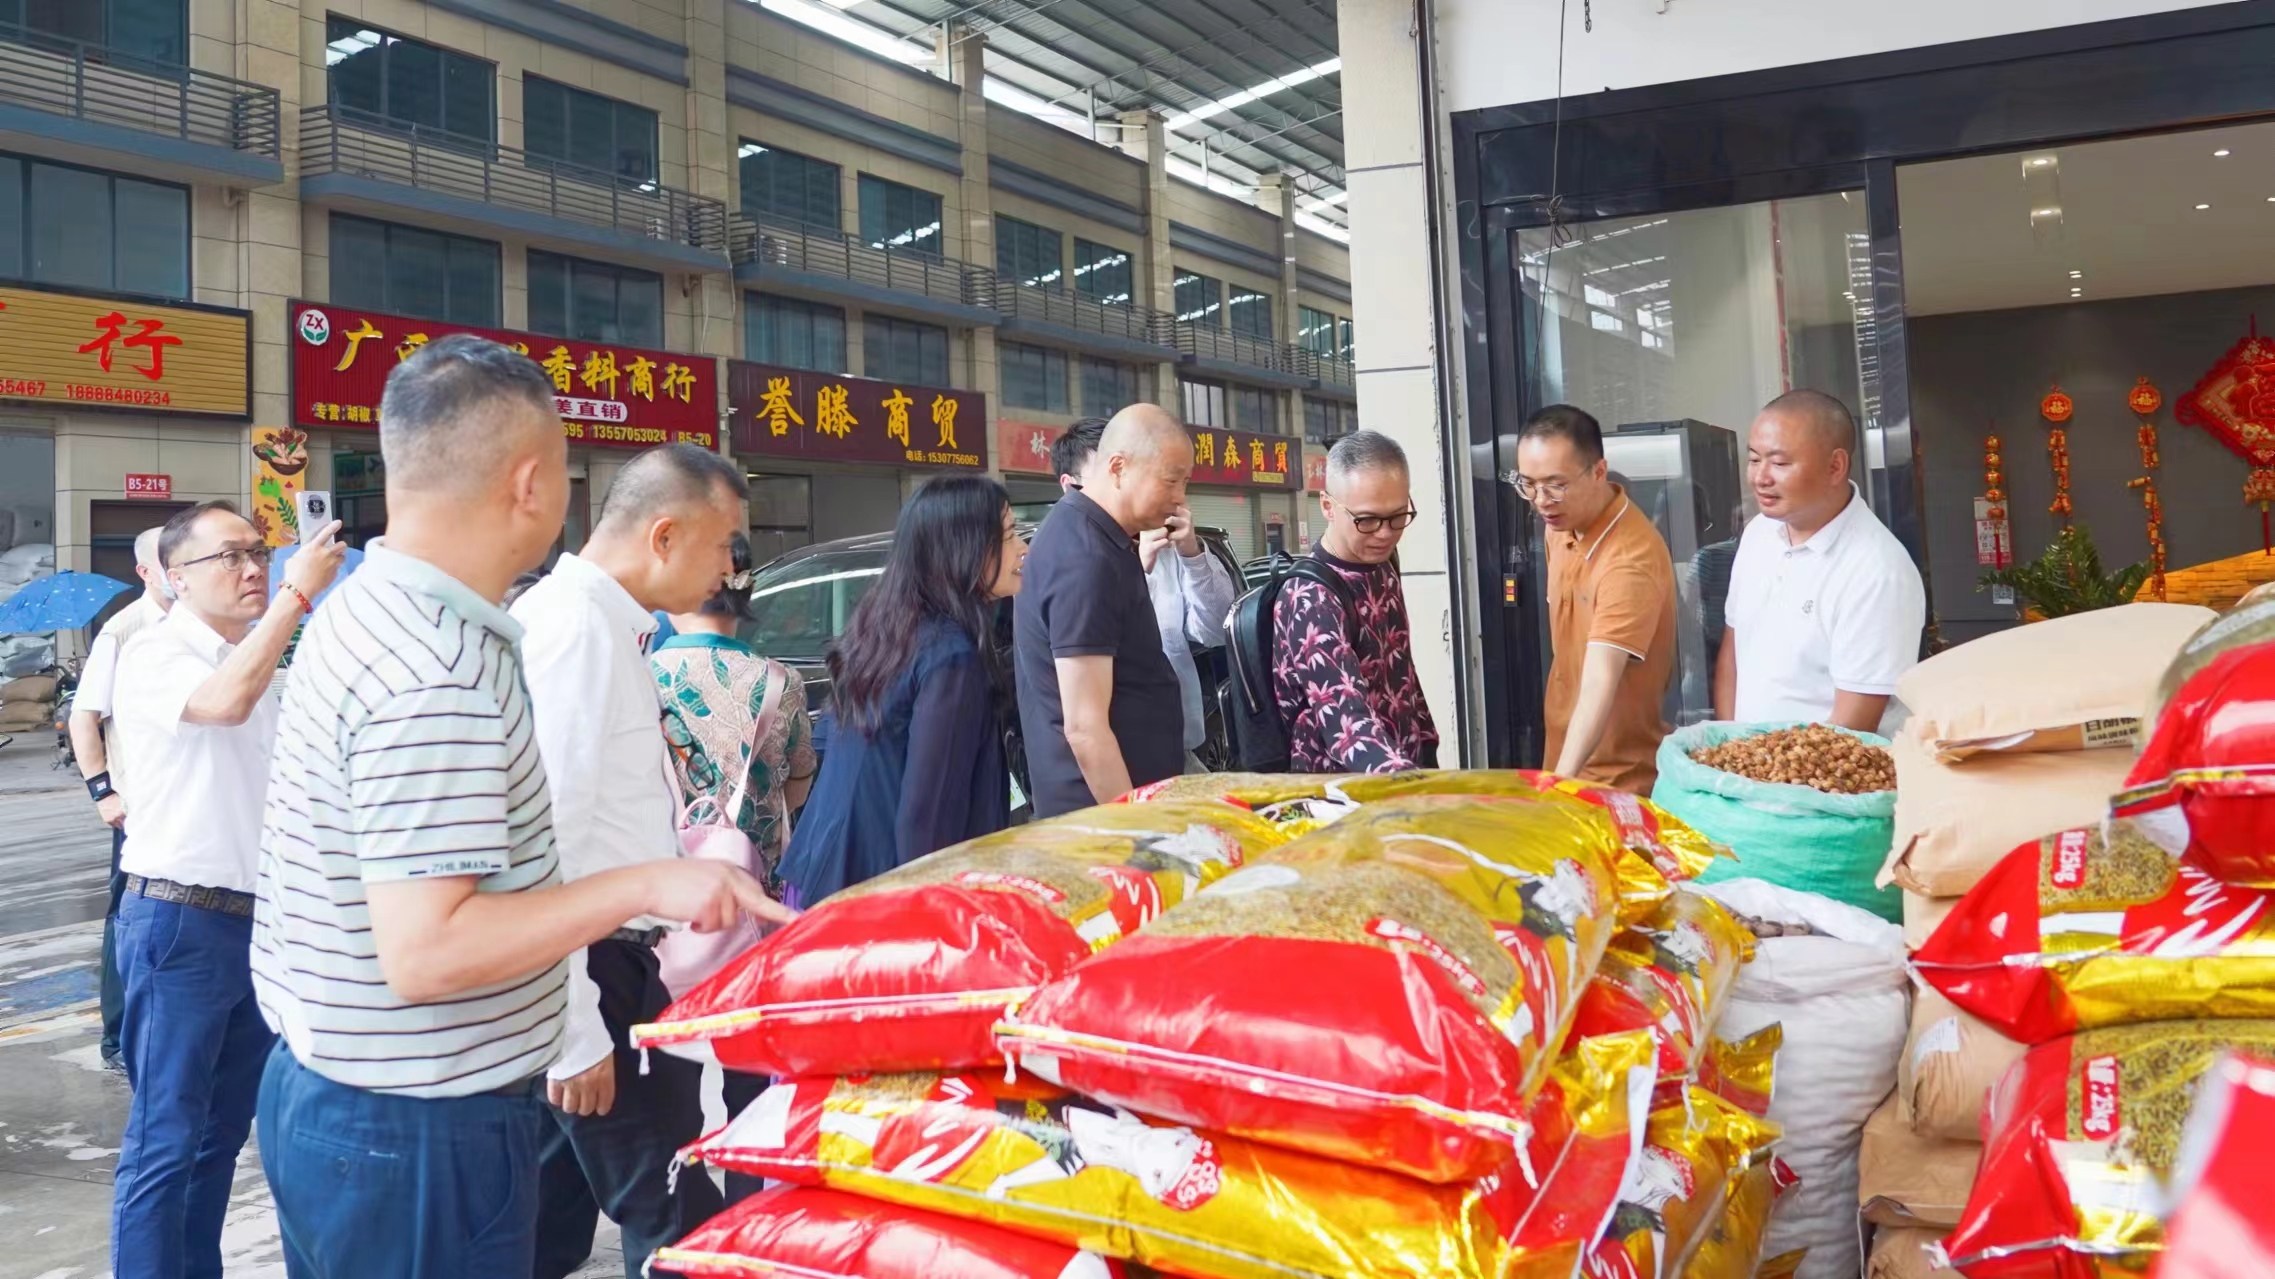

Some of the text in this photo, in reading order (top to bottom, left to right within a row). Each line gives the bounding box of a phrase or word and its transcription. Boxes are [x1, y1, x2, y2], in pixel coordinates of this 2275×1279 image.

[306, 314, 324, 330] ZX
[76, 312, 183, 381] 行
[66, 384, 171, 406] 18888480234
[592, 424, 668, 443] 13557053024
[128, 478, 168, 491] B5-21号
